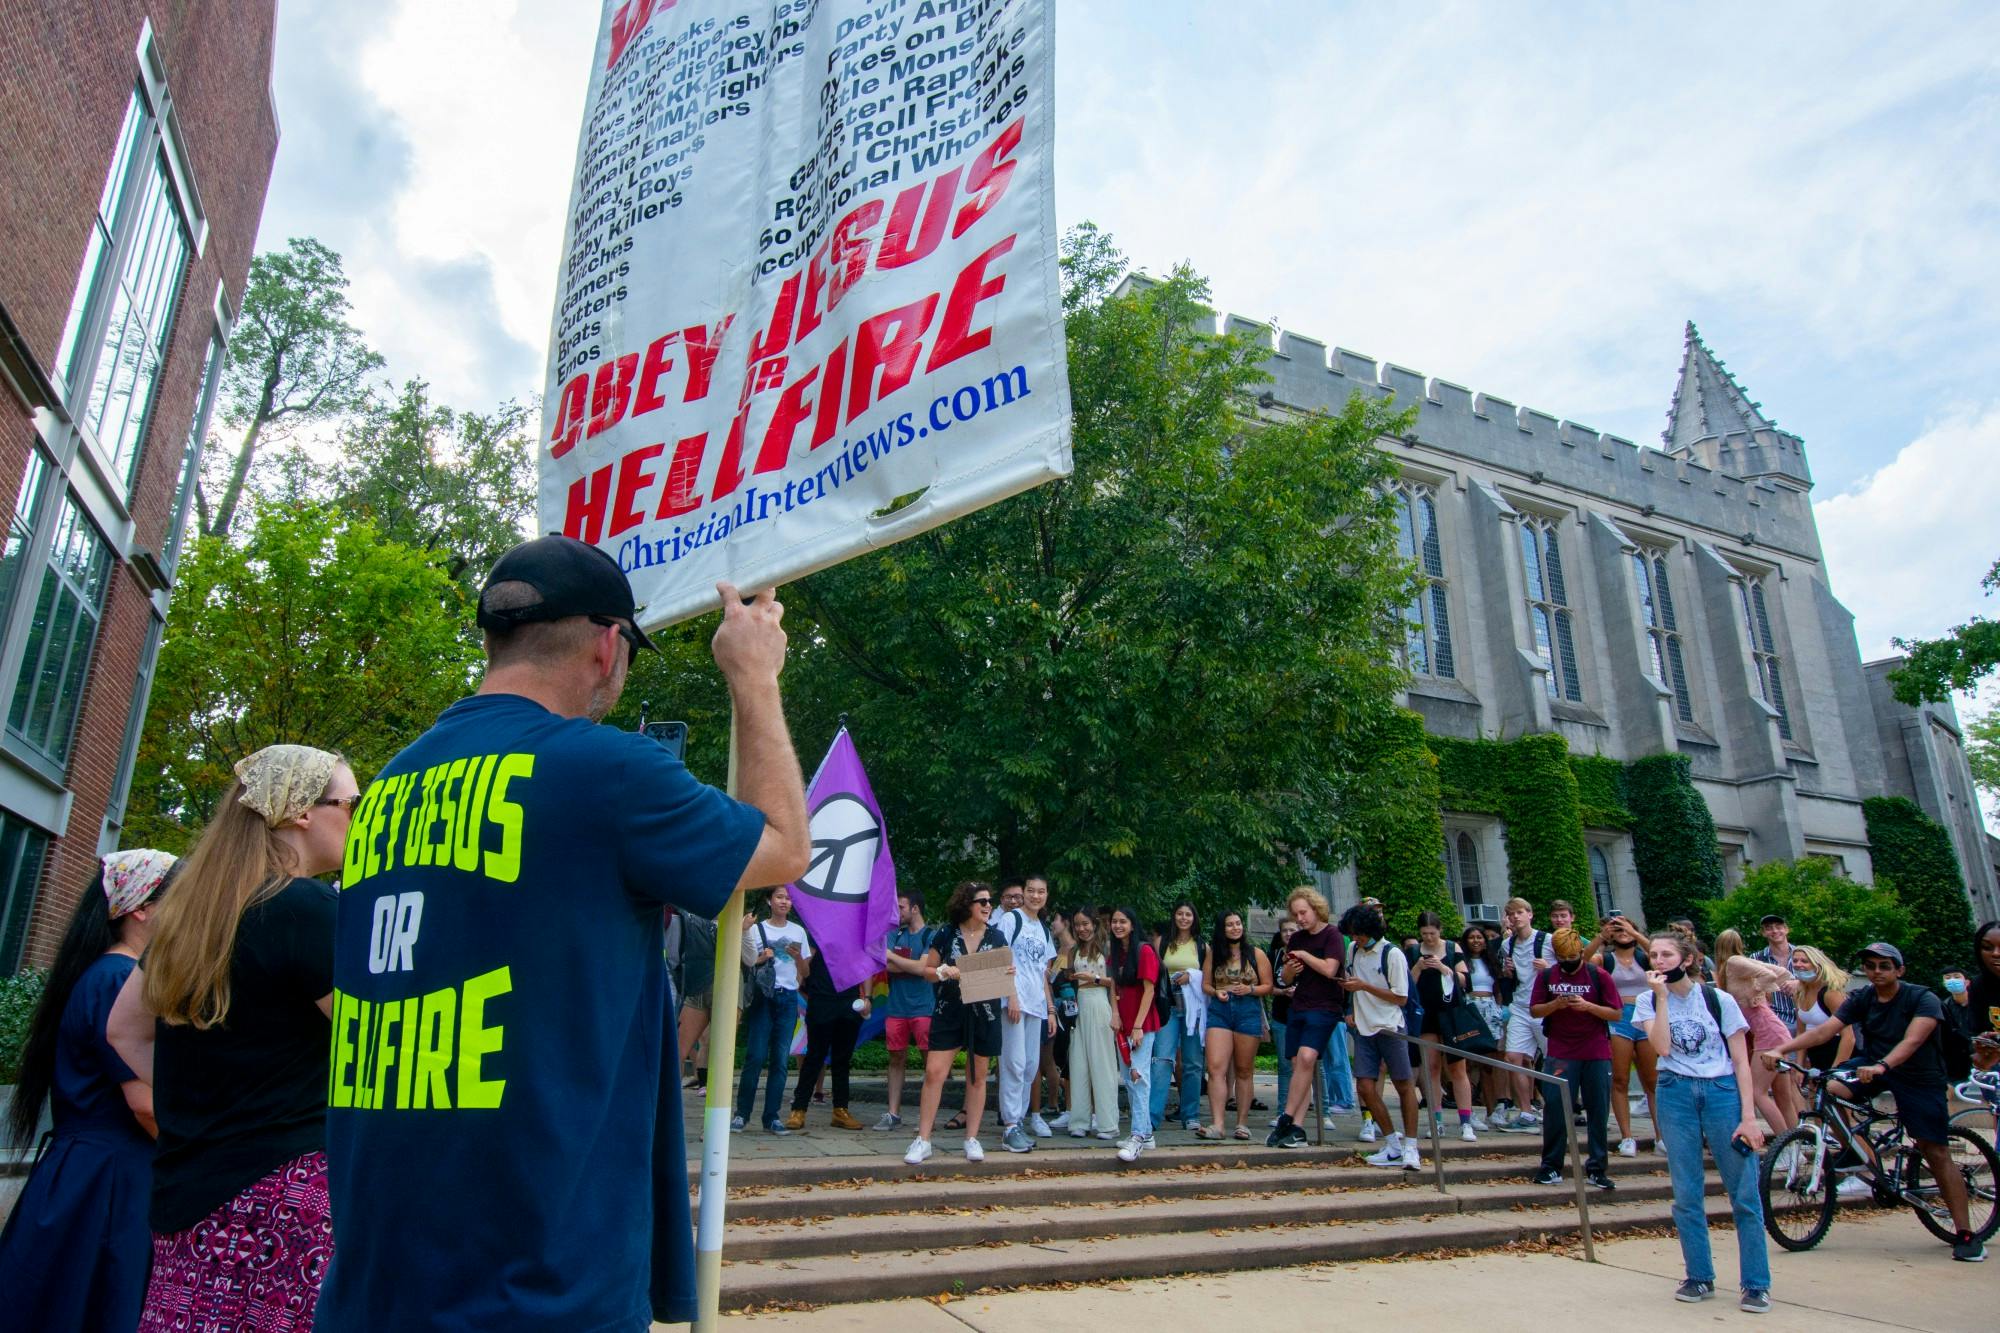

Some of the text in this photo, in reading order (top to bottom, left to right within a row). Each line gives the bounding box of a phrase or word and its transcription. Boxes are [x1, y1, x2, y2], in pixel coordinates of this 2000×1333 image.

[627, 15, 750, 103] Worshipers
[631, 81, 667, 117] who
[671, 29, 766, 87] disobey
[645, 17, 715, 75] Freaks
[816, 0, 1011, 141] Little Monste
[820, 44, 897, 111] Dykes
[905, 25, 945, 51] on
[827, 15, 904, 75] Party
[575, 101, 751, 214] Female Enablers
[579, 134, 641, 193] Women
[645, 98, 699, 140] MMA
[759, 54, 1025, 255] So Called Christians
[774, 164, 826, 221] Rock
[852, 103, 917, 147] Roll
[925, 27, 1026, 119] Freaks
[789, 94, 894, 192] Gangster
[570, 165, 694, 254] Mama's Boys
[574, 184, 623, 237] Money
[751, 84, 1028, 287] Occupational Whores
[566, 236, 634, 296] Witches
[568, 191, 683, 277] Baby Killers
[550, 114, 1026, 460] OBEY JESUS
[558, 285, 628, 340] Cutters
[561, 261, 630, 317] Gamers
[557, 321, 601, 363] Brats
[557, 344, 601, 387] Emos
[738, 355, 789, 411] OR
[617, 364, 1031, 574] ChristianInterviews.com
[342, 753, 535, 890] BEY JESUS
[368, 891, 424, 974] OR
[328, 965, 512, 1109] ELLFIRE
